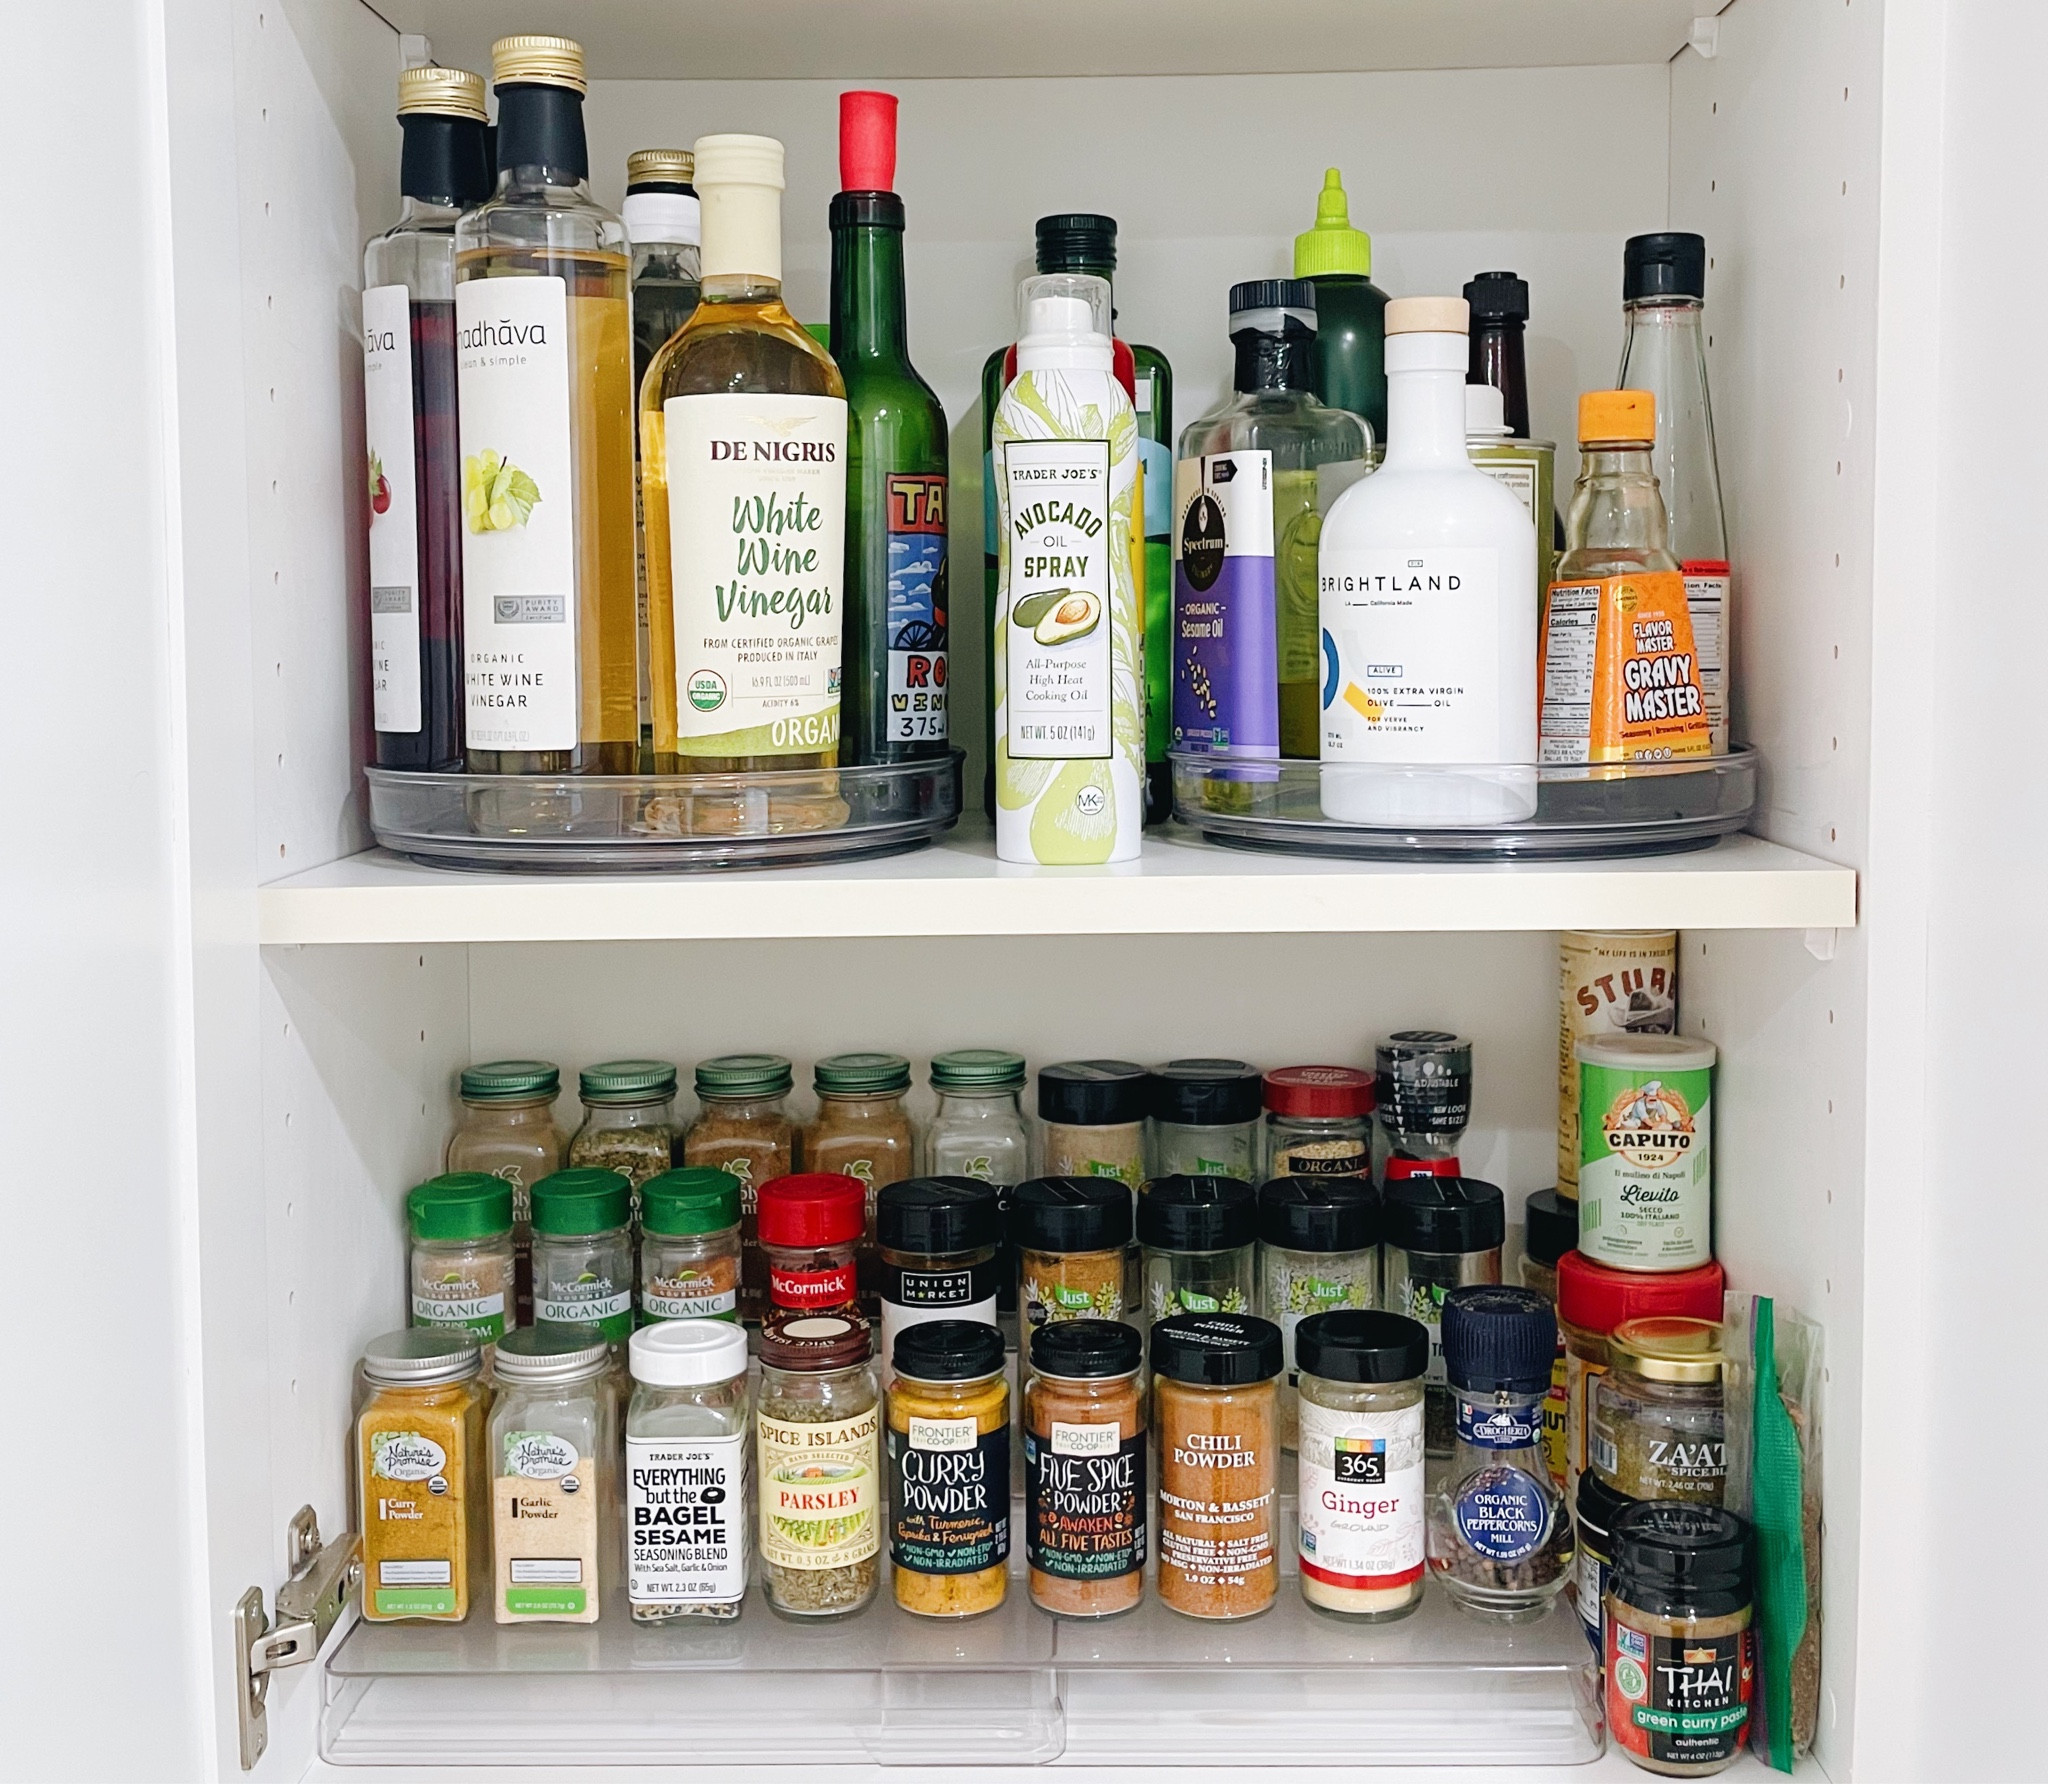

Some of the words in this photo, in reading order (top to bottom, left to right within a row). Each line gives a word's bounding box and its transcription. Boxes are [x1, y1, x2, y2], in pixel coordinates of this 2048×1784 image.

[711, 440, 748, 461] DE
[753, 441, 836, 463] NIGRIS
[1012, 469, 1058, 480] TRADER
[1061, 469, 1098, 480] JOE'S
[733, 491, 823, 536] White
[1014, 500, 1104, 541] AVOCADO
[1043, 535, 1068, 548] OIL
[1183, 538, 1223, 553] Spectrum
[738, 537, 820, 576] Wine
[1024, 556, 1090, 578] SPRAY
[1552, 588, 1579, 597] Nutrition
[1581, 587, 1599, 595] Facts
[715, 579, 834, 630] Vinegar
[1185, 602, 1220, 616] ORGANIC
[1181, 620, 1212, 638] Sesame
[1212, 618, 1224, 637] Oil
[1551, 618, 1578, 626] Calories
[1632, 619, 1674, 640] FLAVOR
[703, 638, 729, 649] FROM
[731, 637, 775, 649] CERTIFIED
[777, 637, 814, 647] ORGANIC
[1636, 636, 1675, 655] MASTER
[470, 654, 524, 663] ORGANIC
[737, 651, 782, 663] PRODUCED
[784, 651, 794, 661] IN
[797, 650, 819, 661] ITALY
[1026, 658, 1087, 673] All-Purpose
[1374, 666, 1396, 674] ALIVE
[1623, 653, 1692, 692] GRAVY
[499, 673, 543, 686] WINE
[694, 680, 718, 690] USDA
[1030, 673, 1054, 688] High
[1058, 673, 1084, 685] Heat
[1025, 689, 1067, 703] Cooking
[1071, 689, 1089, 701] Oil
[1368, 687, 1389, 695] 100%
[1394, 686, 1425, 695] EXTRA
[1429, 686, 1464, 695] VIRGIN
[470, 694, 527, 708] VINEGAR
[1368, 699, 1395, 707] OLIVE
[1434, 699, 1451, 707] OIL
[1625, 684, 1702, 725] MASTER
[1619, 729, 1652, 739] Seasoning
[1655, 726, 1684, 736] Browning
[1413, 1078, 1459, 1089] ADJUSTABLE
[1432, 1106, 1447, 1117] NEW
[1432, 1116, 1447, 1125] SAME
[1609, 1132, 1690, 1149] CAPUTO
[1637, 1153, 1664, 1162] 1924
[1662, 1171, 1685, 1181] Napoli
[1619, 1184, 1680, 1206] Lievito
[1620, 1211, 1644, 1220] 100%
[1638, 1206, 1663, 1214] SECCO
[422, 1279, 481, 1292] McCormick
[551, 1276, 614, 1293] McCormick
[654, 1274, 717, 1289] McCormick
[771, 1273, 847, 1295] McCormick
[906, 1277, 966, 1288] UNION
[659, 1288, 714, 1298] GOURMET
[1060, 1289, 1090, 1305] Just
[1186, 1295, 1216, 1311] Just
[1313, 1283, 1343, 1298] Just
[416, 1300, 488, 1318] ORGANIC
[545, 1298, 621, 1319] ORGANIC
[649, 1297, 723, 1315] ORGANIC
[760, 1421, 801, 1446] SPICE
[807, 1416, 876, 1447] ISLANDS
[912, 1424, 970, 1438] FRONTIER
[1055, 1430, 1114, 1443] FRONTIER
[926, 1437, 955, 1446] CO-OP
[1070, 1442, 1099, 1451] CO-OP
[1186, 1433, 1242, 1451] CHILI
[388, 1442, 434, 1459] Nature's
[521, 1441, 567, 1458] Nature's
[649, 1453, 684, 1461] TRADER
[686, 1453, 712, 1461] JOE'S
[788, 1454, 813, 1463] HAND
[816, 1451, 850, 1461] SELECTED
[1173, 1447, 1256, 1469] POWDER
[394, 1467, 428, 1478] Organic
[526, 1465, 561, 1477] Organic
[901, 1449, 985, 1486] CURRY
[1039, 1451, 1084, 1492] FIVE
[1086, 1453, 1136, 1493] SPICE
[1671, 1467, 1709, 1480] SPICE
[633, 1467, 726, 1487] EVERYTHING
[520, 1496, 553, 1508] Garlic
[646, 1486, 672, 1505] but
[673, 1486, 697, 1503] the
[780, 1486, 861, 1510] PARSLEY
[903, 1479, 988, 1514] POWDER
[1054, 1490, 1122, 1515] POWDER
[1159, 1488, 1206, 1513] MORTON
[1208, 1502, 1220, 1513] &
[1474, 1493, 1529, 1507] ORGANIC
[387, 1498, 416, 1510] Curry
[1321, 1490, 1400, 1520] Ginger
[388, 1509, 424, 1521] Powder
[520, 1508, 559, 1520] Powder
[634, 1505, 726, 1527] BAGEL
[906, 1515, 926, 1526] with
[1174, 1509, 1194, 1522] SAN
[1195, 1512, 1255, 1524] FRANCISCO
[1478, 1506, 1526, 1521] BLACK
[1059, 1515, 1114, 1533] AWAKEN
[1466, 1519, 1539, 1533] PEPPERCORNS
[633, 1528, 727, 1546] SESAME
[932, 1531, 940, 1542] &
[1039, 1527, 1058, 1548] ALL
[1061, 1532, 1089, 1552] FIVE
[1091, 1527, 1134, 1552] TASTES
[1163, 1529, 1175, 1541] ALL
[1176, 1534, 1217, 1549] NATURAL
[1226, 1537, 1249, 1548] SALT
[1250, 1532, 1269, 1543] FREE
[1490, 1533, 1515, 1544] MILL
[633, 1547, 693, 1561] SEASONING
[694, 1547, 728, 1560] BLEND
[905, 1544, 945, 1558] NON-GMO
[1193, 1545, 1216, 1556] FREE
[1226, 1541, 1269, 1557] NON-GMO
[912, 1553, 989, 1569] NON-IRRADIATED
[1045, 1549, 1083, 1564] NON-GMO
[1172, 1549, 1236, 1565] PRESERVATIVE
[1237, 1552, 1258, 1564] FREE
[634, 1563, 651, 1573] With
[652, 1562, 664, 1571] Sea
[665, 1562, 681, 1573] Salt,
[681, 1562, 700, 1572] Garlic
[701, 1562, 706, 1571] &
[707, 1561, 728, 1571] Onion
[1053, 1558, 1129, 1575] NON-IRRADIATED
[1197, 1555, 1273, 1573] NON-IRRADIATED
[1184, 1573, 1199, 1583] 1.9
[1200, 1574, 1216, 1585] OZ
[1227, 1574, 1246, 1586] 54g
[647, 1584, 660, 1593] NET
[675, 1584, 687, 1593] 2.3
[688, 1583, 697, 1592] OZ
[1656, 1664, 1733, 1698] THAI
[1666, 1696, 1730, 1709] KITCHEN
[1637, 1710, 1679, 1729] green
[1681, 1714, 1719, 1731] curry
[1675, 1738, 1720, 1748] authentic
